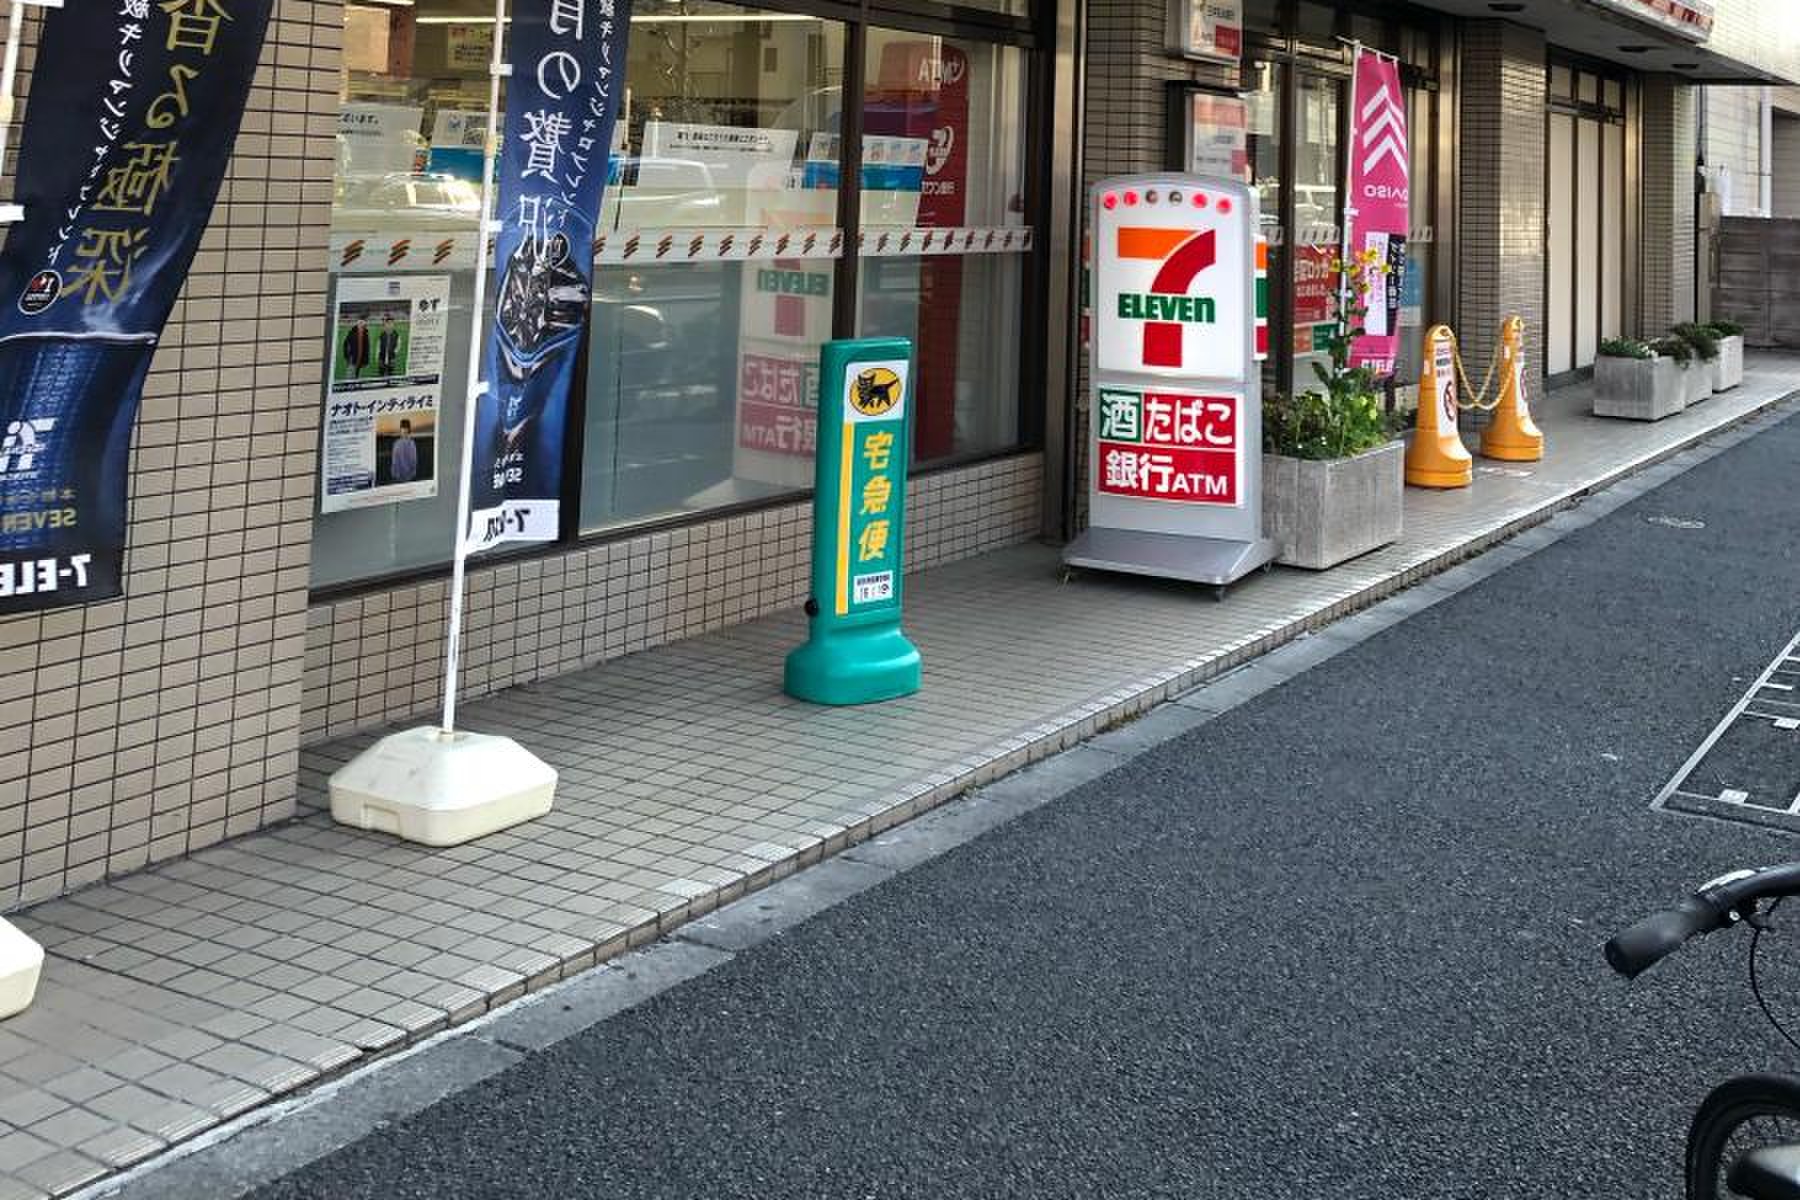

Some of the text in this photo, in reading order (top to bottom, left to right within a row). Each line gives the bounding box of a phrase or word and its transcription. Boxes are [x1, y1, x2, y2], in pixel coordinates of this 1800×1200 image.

[1101, 392, 1233, 445] 酒 たばこ
[859, 431, 894, 562] 宅急便
